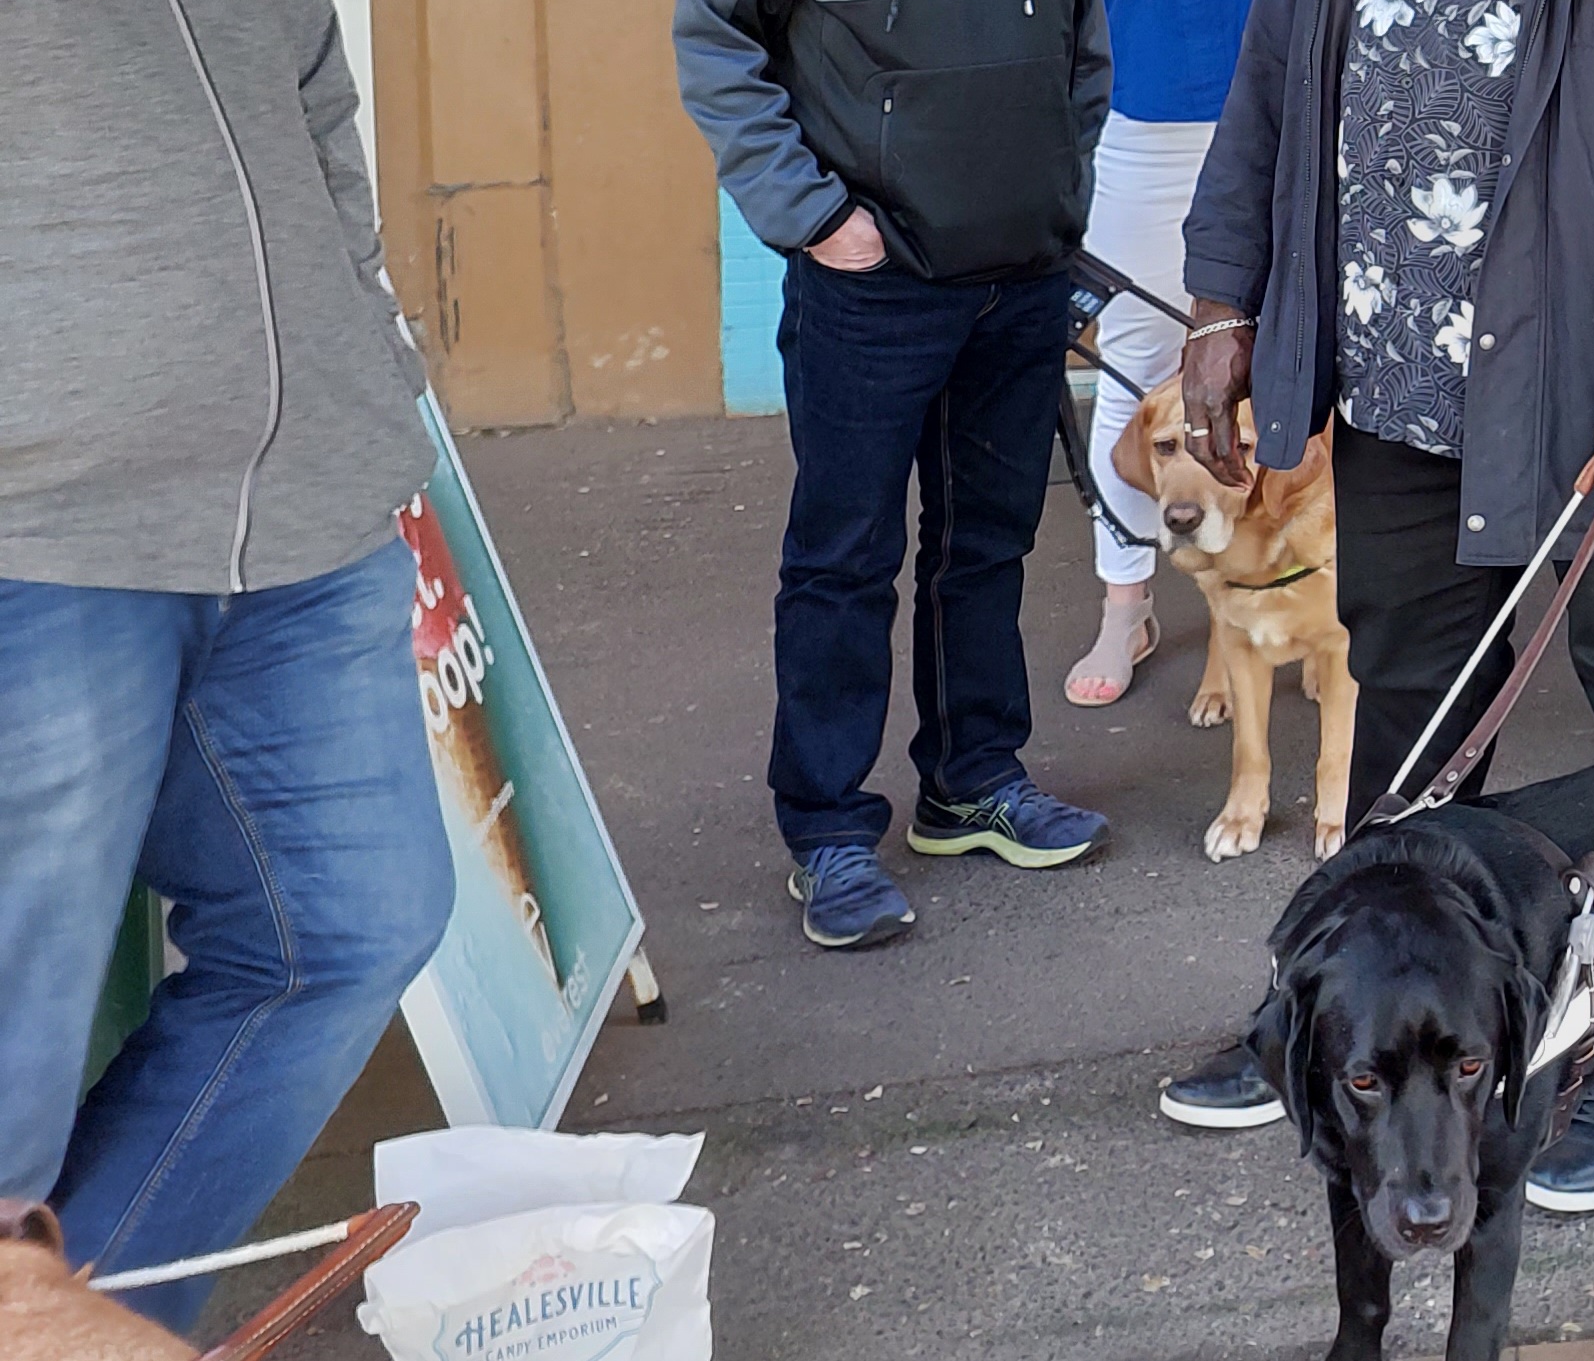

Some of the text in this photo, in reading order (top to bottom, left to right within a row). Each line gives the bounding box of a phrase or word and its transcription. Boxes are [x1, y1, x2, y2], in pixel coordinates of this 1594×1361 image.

[455, 1277, 645, 1356] HEALESVILLE
[486, 1316, 618, 1361] CANDY EMPORIUM
